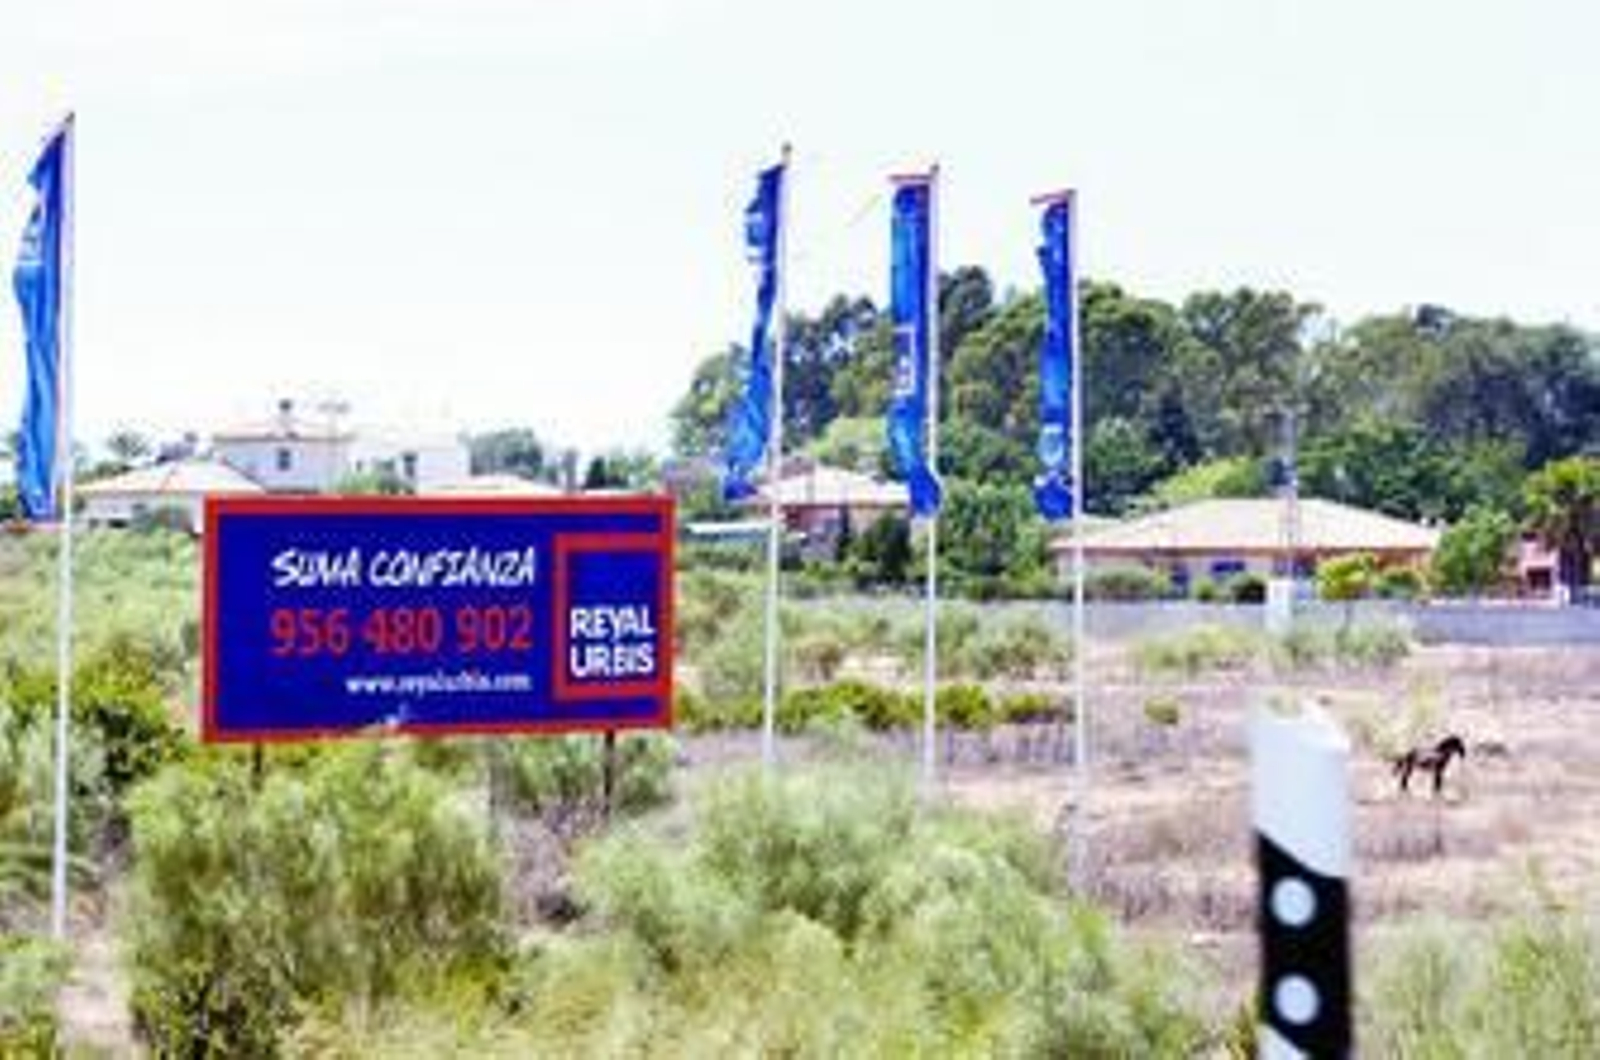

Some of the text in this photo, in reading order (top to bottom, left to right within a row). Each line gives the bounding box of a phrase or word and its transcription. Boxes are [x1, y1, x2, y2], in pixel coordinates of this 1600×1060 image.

[271, 546, 535, 588] SUMA CONFIANZA
[271, 606, 533, 656] 956 480 902
[570, 605, 656, 639] REYAL
[570, 643, 654, 678] URBIS
